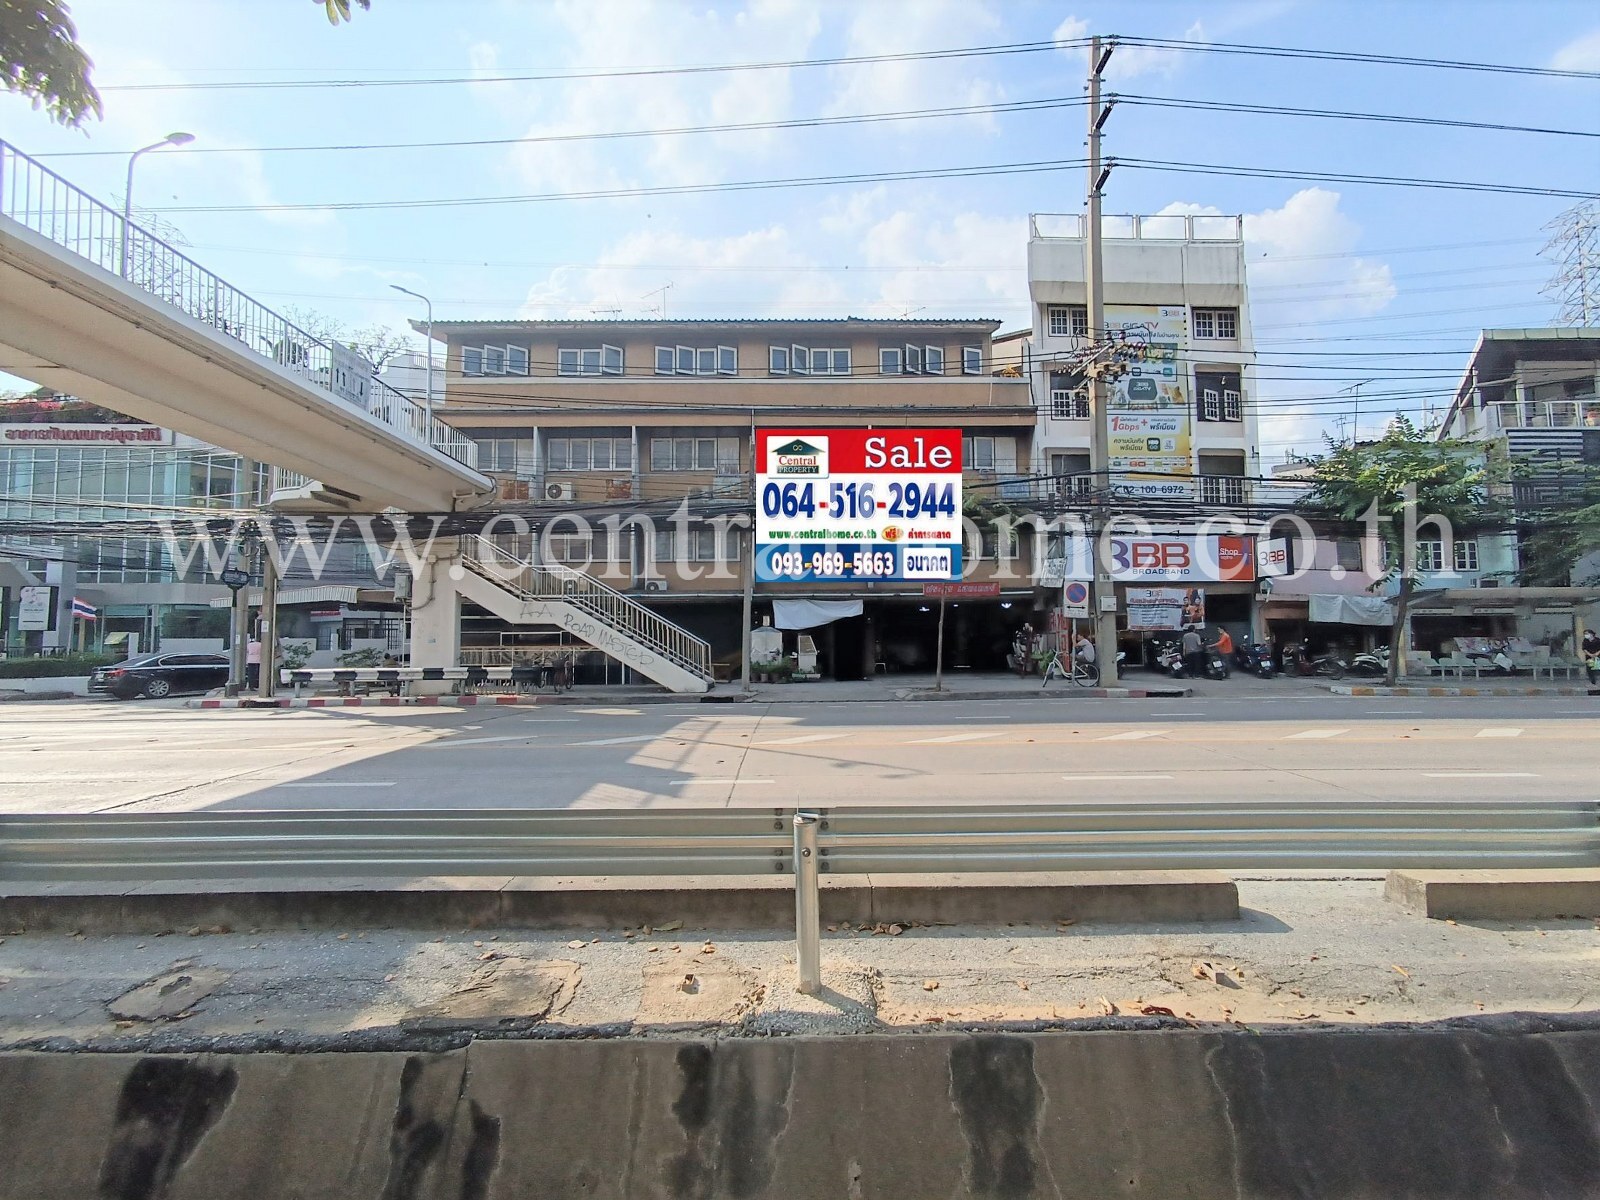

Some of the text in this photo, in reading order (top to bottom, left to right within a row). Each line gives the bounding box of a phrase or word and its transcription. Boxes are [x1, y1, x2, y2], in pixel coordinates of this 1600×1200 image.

[779, 455, 817, 466] Central
[865, 437, 952, 468] Sale
[762, 481, 956, 520] 064-516-2944
[768, 528, 877, 539] www.centralhome.co.th
[908, 528, 952, 539] ค่าการตลาด
[1111, 539, 1190, 573] 3BB
[1219, 547, 1239, 557] Shop
[1258, 549, 1286, 567] 3BB
[771, 551, 895, 576] 093-969-5663
[906, 554, 949, 572] อนาคต
[564, 613, 596, 638] ROAD
